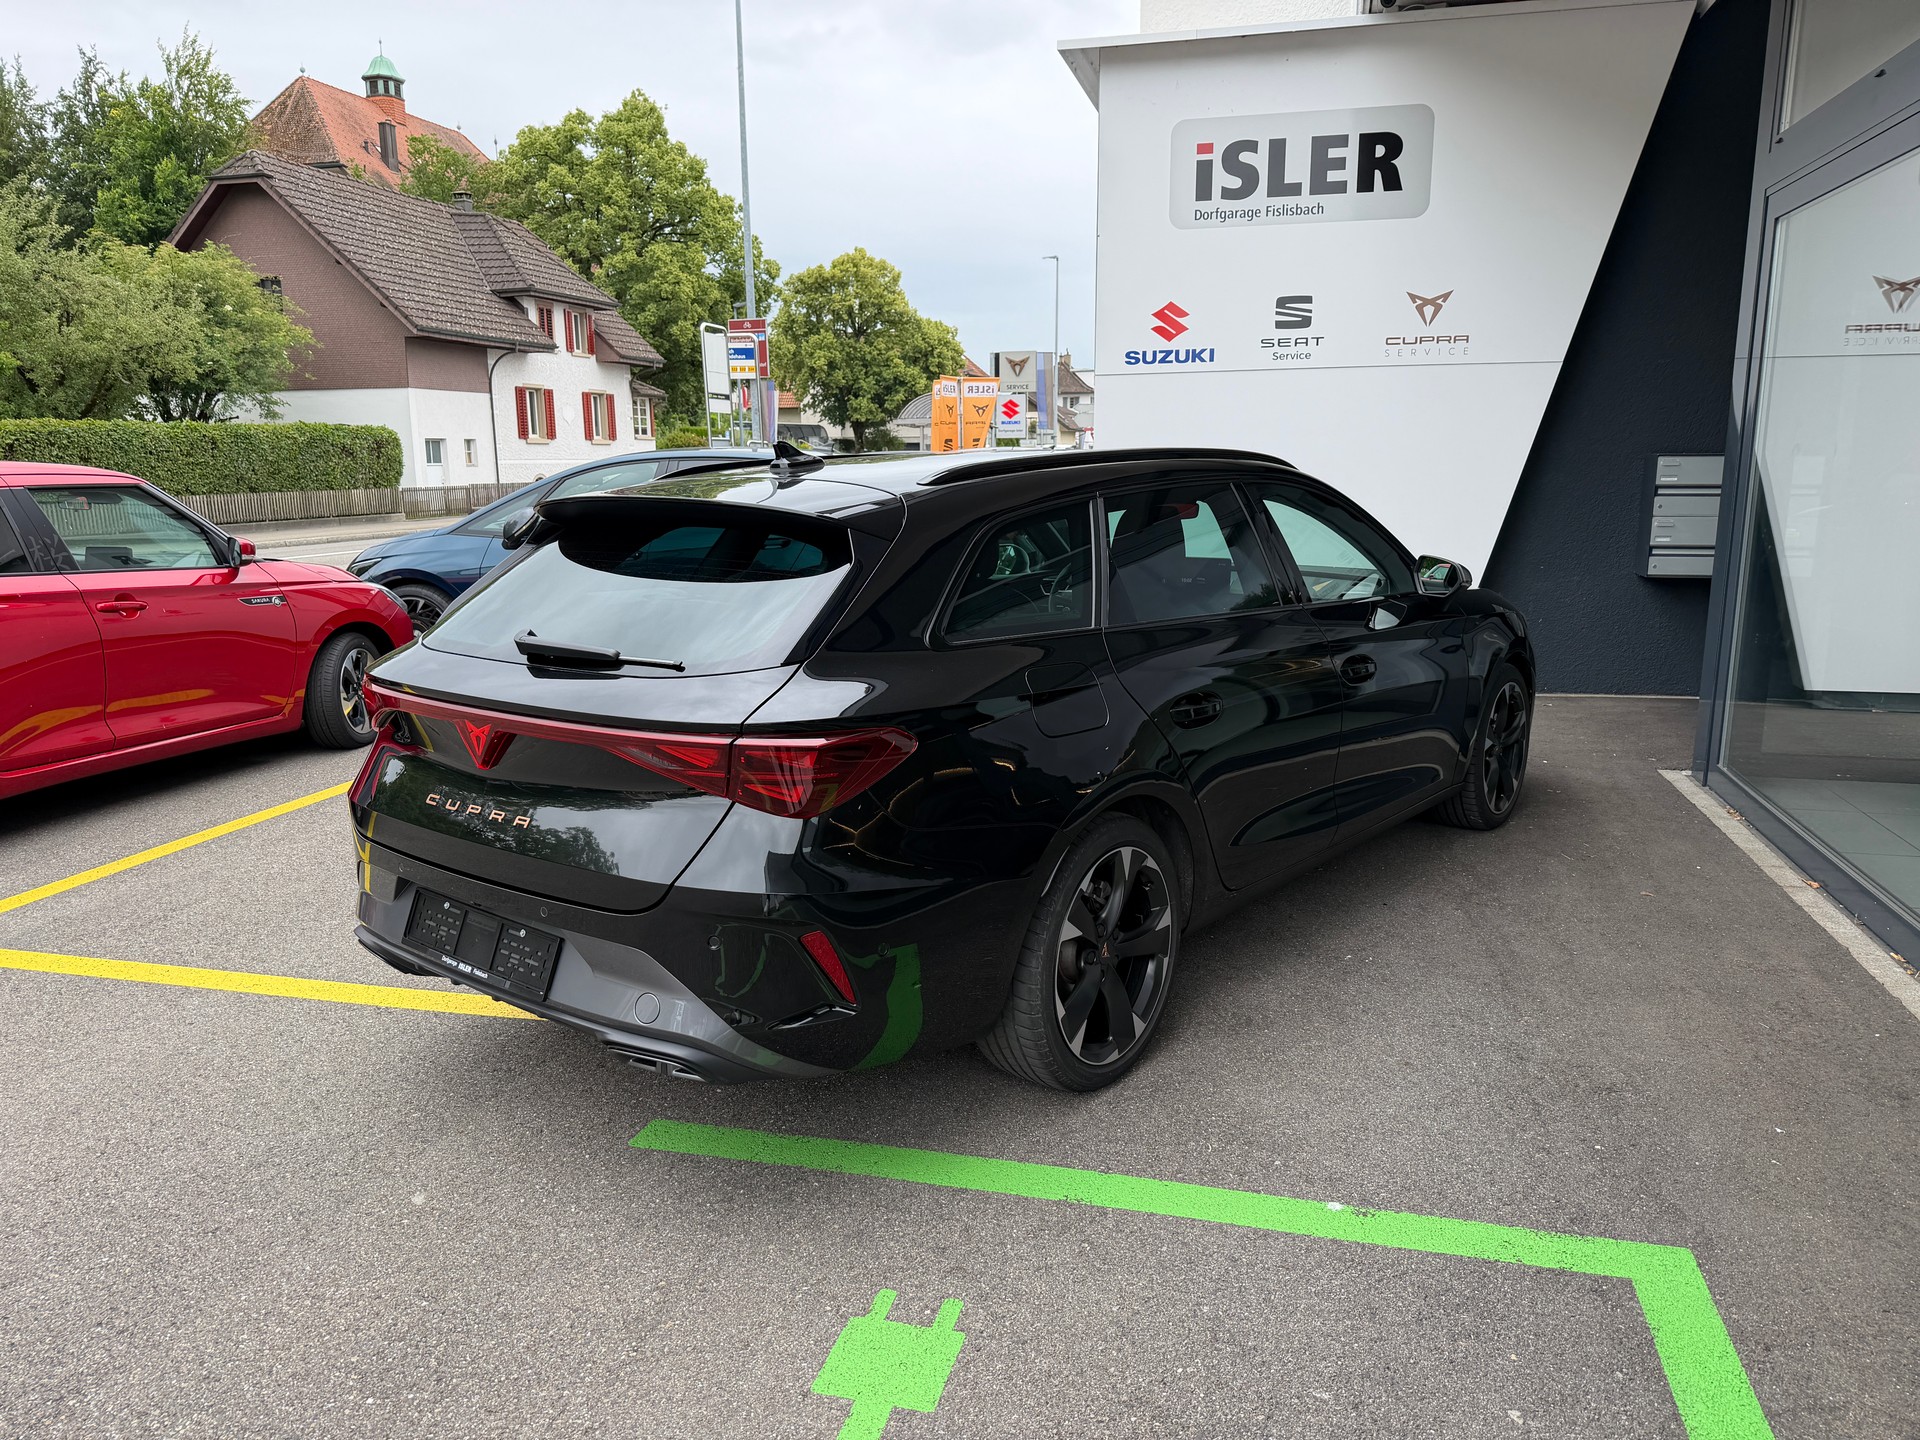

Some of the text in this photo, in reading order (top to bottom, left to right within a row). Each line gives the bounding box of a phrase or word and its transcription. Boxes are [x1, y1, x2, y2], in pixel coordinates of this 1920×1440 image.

[1194, 202, 1325, 223] Dorfgarage Fislisbach
[1260, 336, 1325, 349] SEAT
[1385, 334, 1470, 346] CUPRA
[1124, 347, 1216, 366] SUZUKI
[1272, 350, 1312, 361] Service
[1384, 346, 1470, 358] SERVICE
[425, 793, 531, 829] CUPRA
